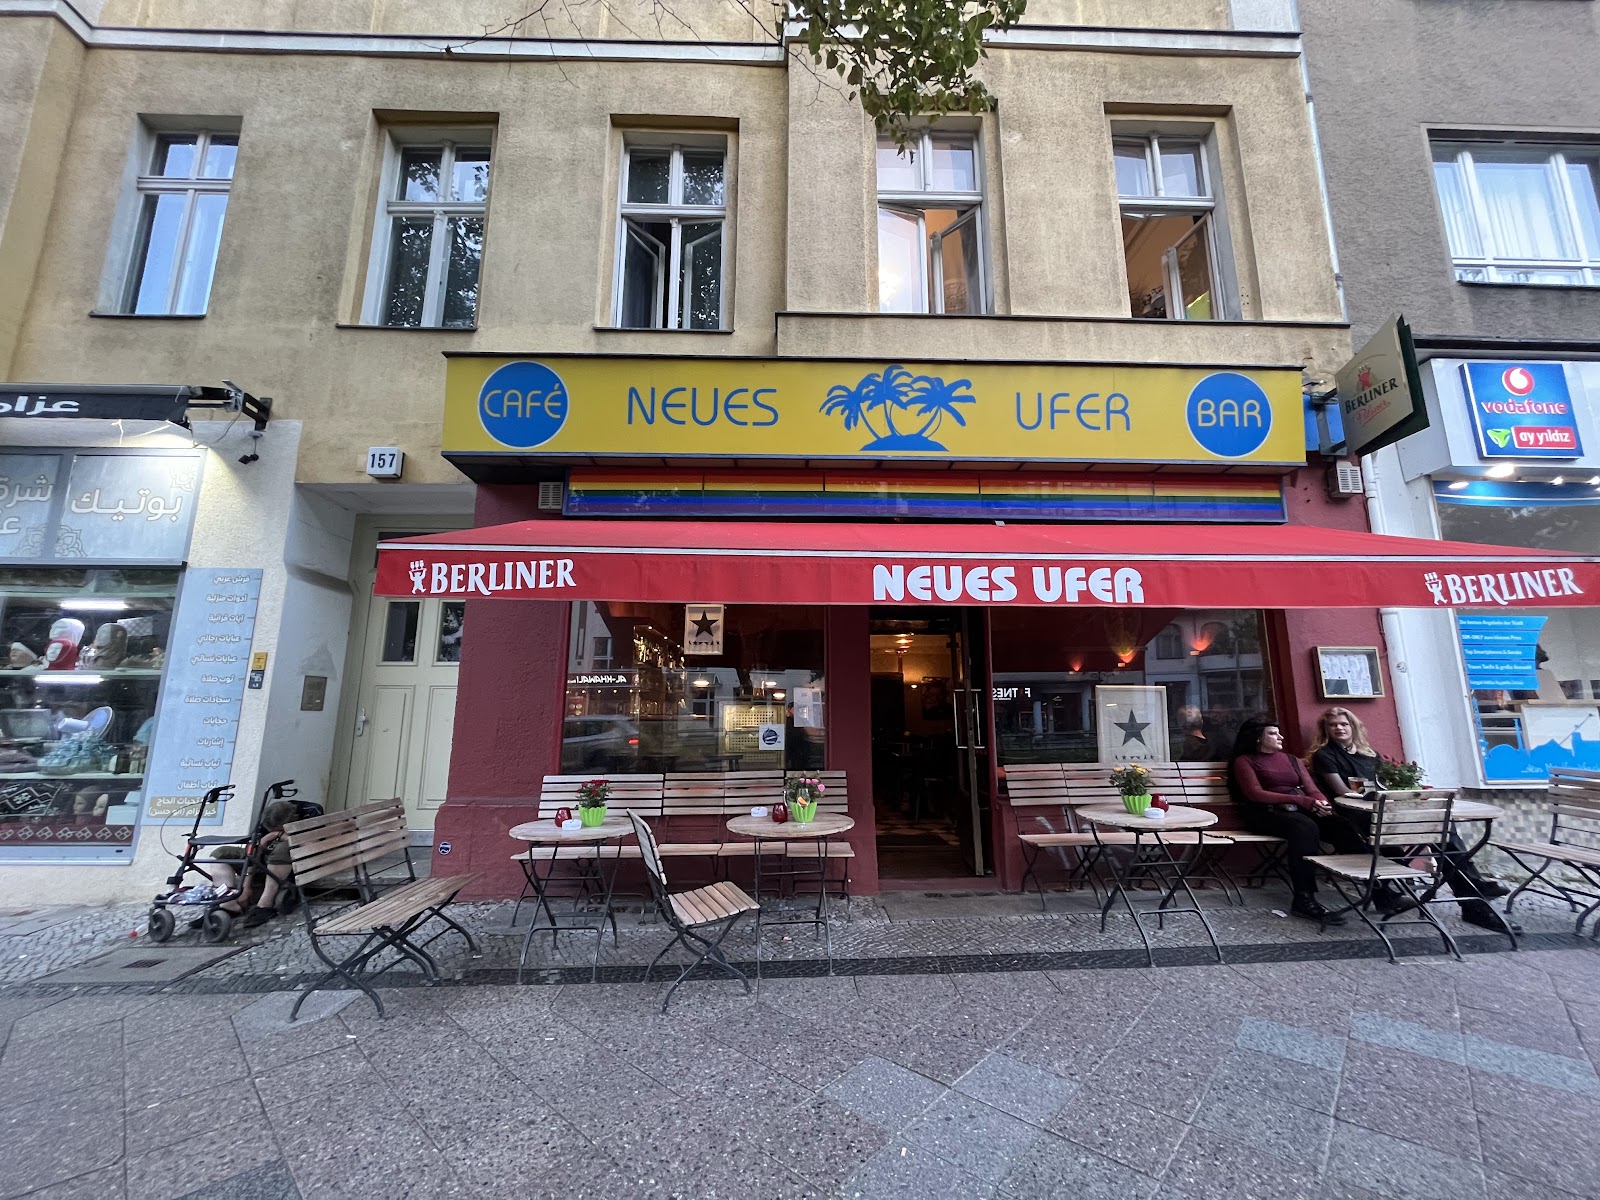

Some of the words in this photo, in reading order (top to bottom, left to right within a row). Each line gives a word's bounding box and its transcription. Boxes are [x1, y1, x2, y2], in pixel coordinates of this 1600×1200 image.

[483, 383, 562, 419] CAFÉ
[627, 387, 779, 426] NEUES
[1016, 392, 1131, 431] UFER
[1197, 399, 1262, 428] BAR
[1344, 378, 1399, 414] BERLINER
[1481, 398, 1567, 415] vodafone
[1519, 432, 1536, 446] ay
[370, 453, 397, 469] 157
[71, 488, 183, 522] بوتيك
[213, 575, 232, 585] عربي
[429, 558, 577, 596] BERLINER
[873, 565, 1018, 601] NEUES
[1032, 566, 1145, 603] UFER
[1444, 568, 1584, 605] BERLINER
